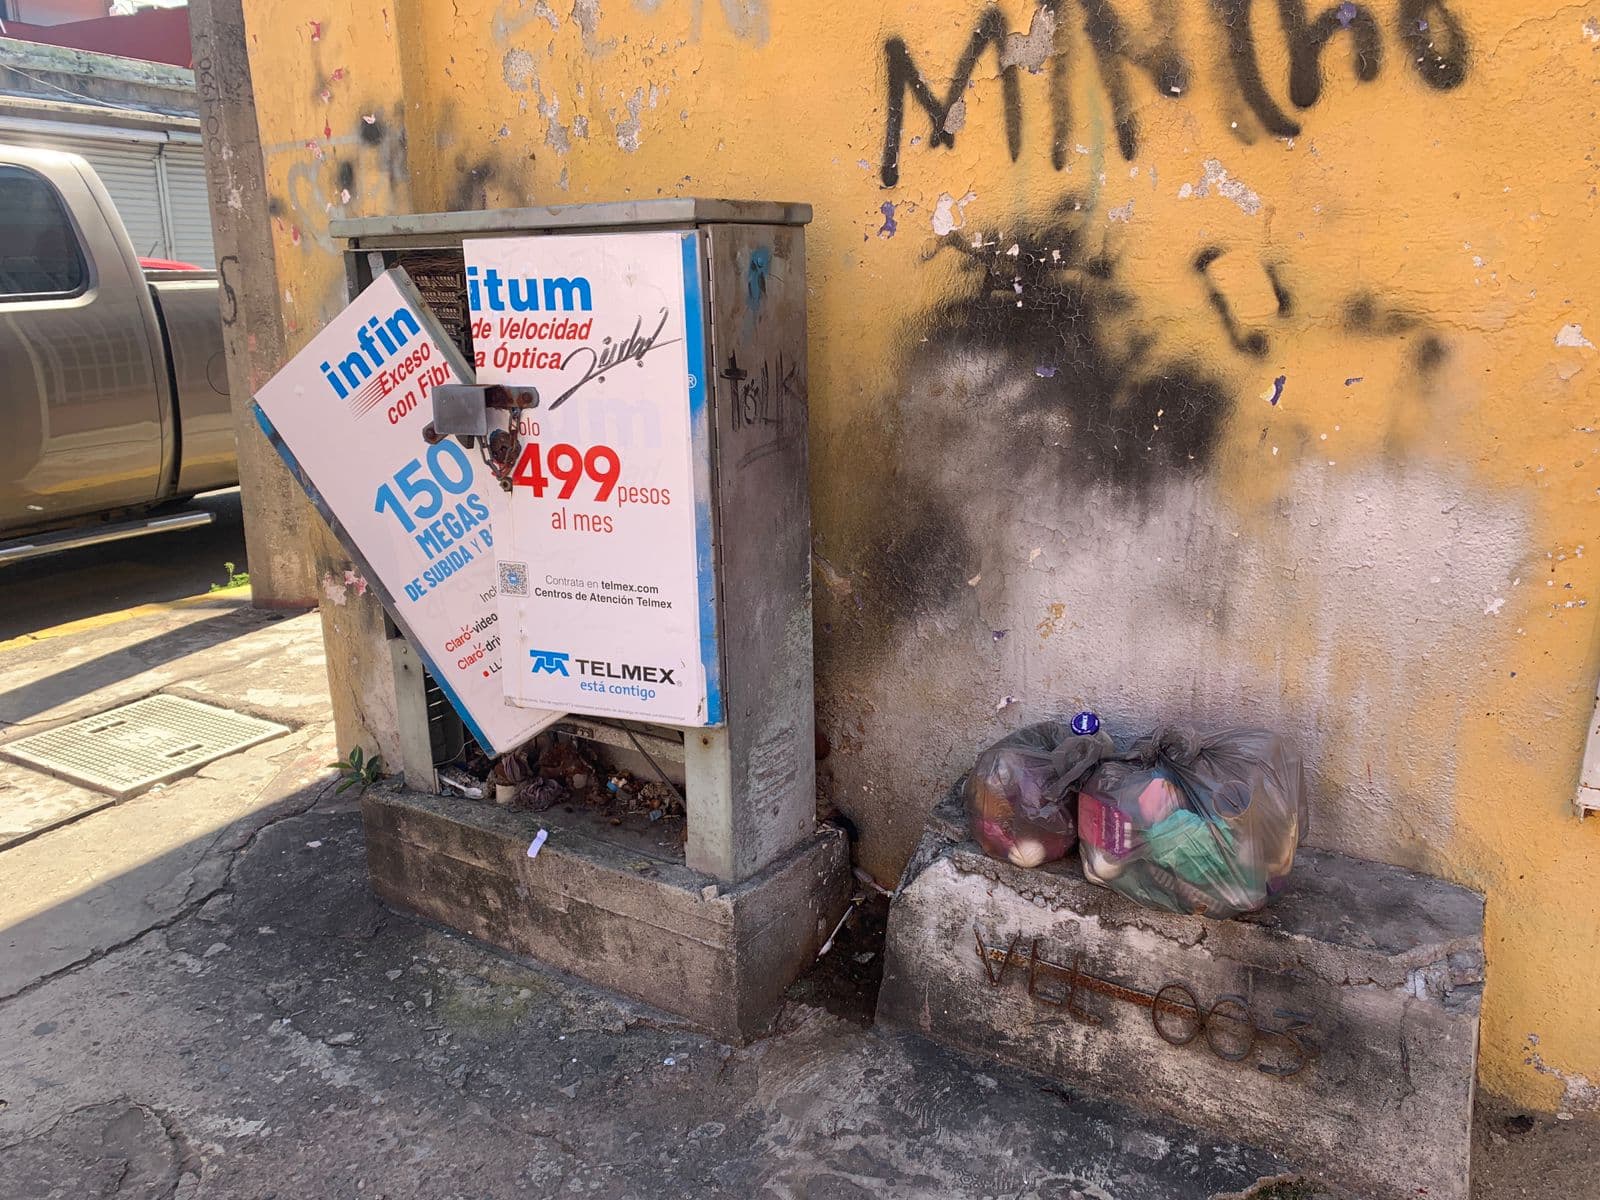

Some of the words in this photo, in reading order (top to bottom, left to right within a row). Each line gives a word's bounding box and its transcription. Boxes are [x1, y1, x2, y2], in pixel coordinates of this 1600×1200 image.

[467, 266, 593, 312] itum
[471, 317, 492, 339] de
[499, 317, 594, 341] Velocidad
[320, 308, 421, 400] infin
[493, 342, 562, 373] Óptica
[378, 342, 431, 396] Exceso
[388, 390, 418, 425] con
[417, 361, 450, 399] Fibr
[517, 417, 541, 437] olo
[374, 438, 474, 534] 150
[617, 485, 671, 508] pesos
[414, 493, 490, 560] MEGAS
[551, 507, 567, 530] al
[573, 512, 614, 533] mes
[404, 577, 427, 602] DE
[422, 544, 474, 588] SUBIDA
[470, 537, 482, 554] Y
[534, 587, 573, 601] Centros
[575, 590, 588, 602] de
[589, 592, 634, 606] Atención
[636, 596, 673, 609] Telmex
[545, 574, 585, 588] Contrata
[586, 579, 599, 589] en
[600, 580, 659, 595] telmex.com
[575, 658, 676, 686] TELMEX
[579, 680, 606, 693] está
[608, 683, 656, 701] contigo
